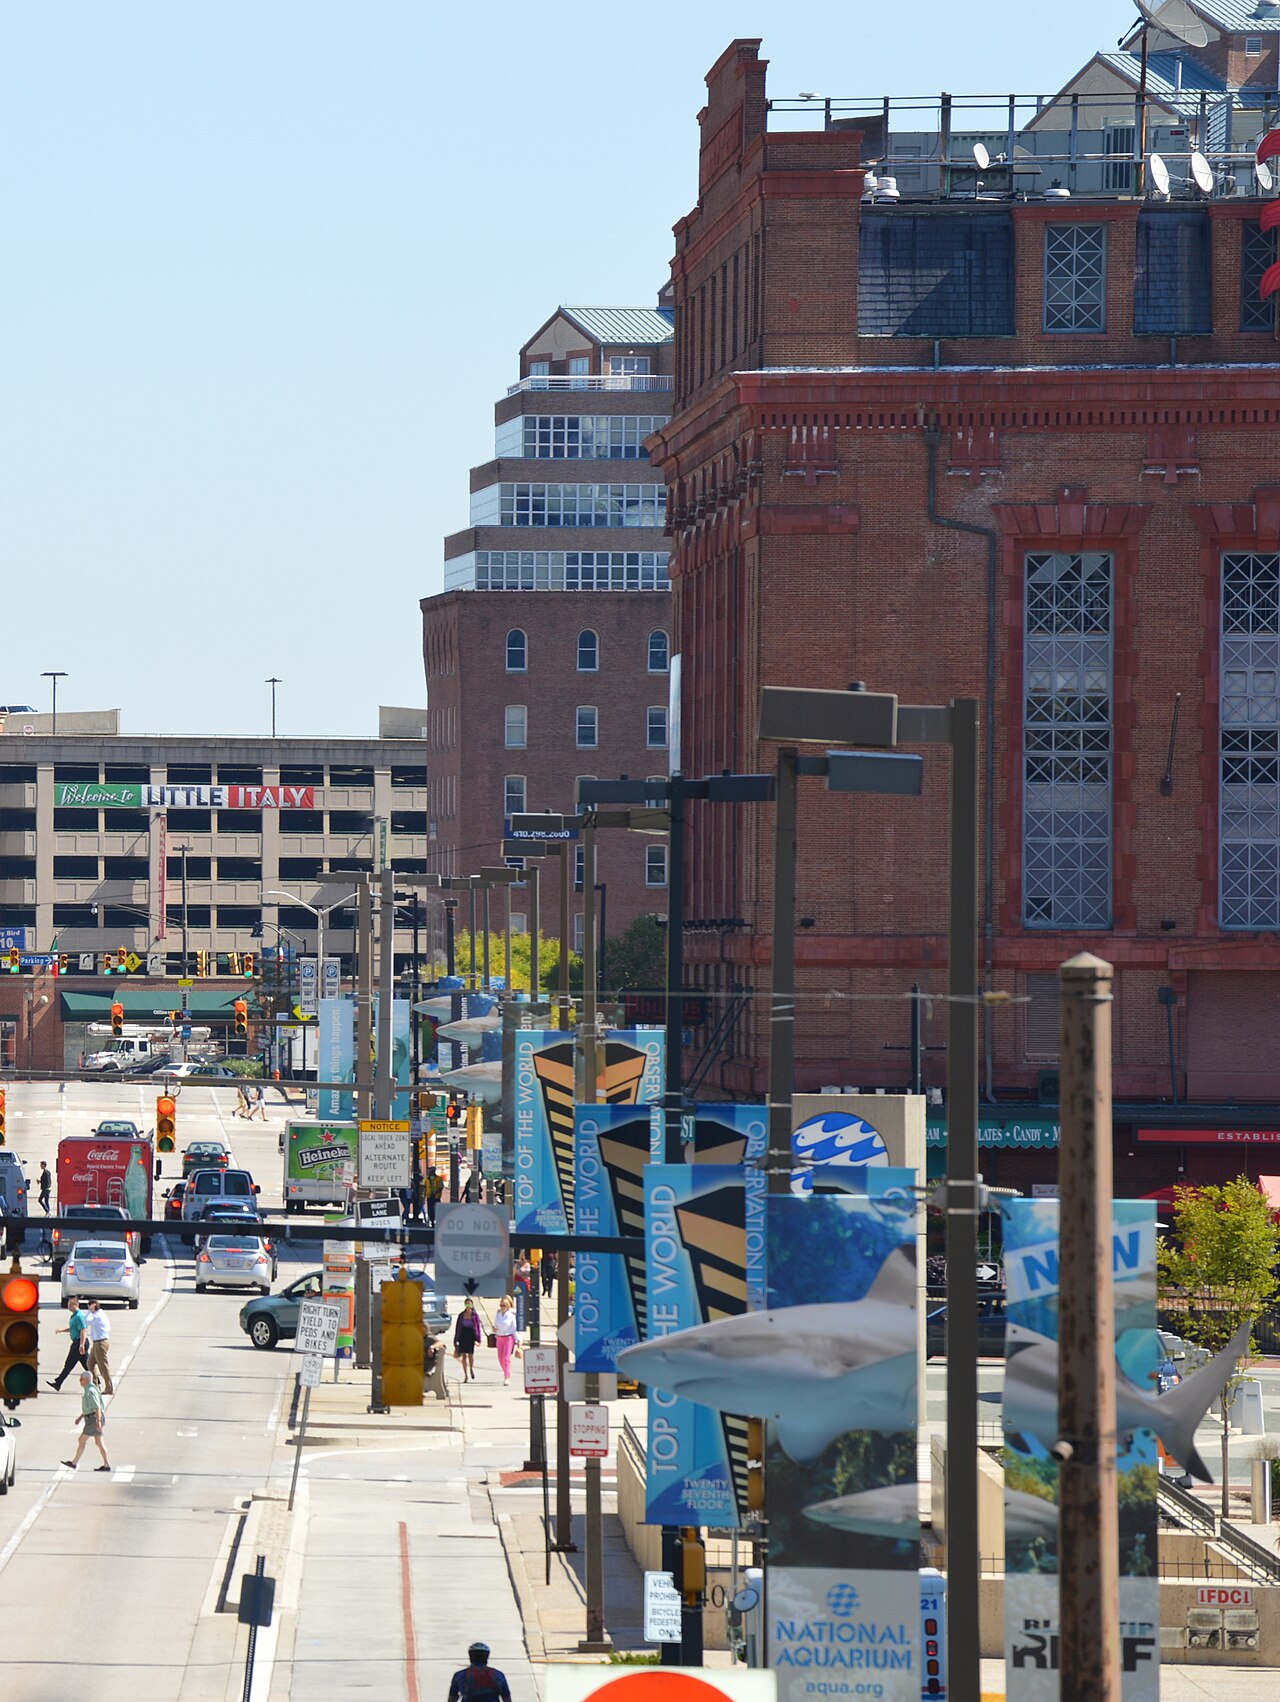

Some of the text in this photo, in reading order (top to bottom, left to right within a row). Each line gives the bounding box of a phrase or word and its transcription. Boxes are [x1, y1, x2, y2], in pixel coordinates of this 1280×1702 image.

[60, 783, 307, 808] Welcome to LITTLE ITALY
[20, 957, 43, 965] Parking
[518, 1042, 534, 1105] WORLD
[328, 1076, 342, 1115] Amazg
[518, 1110, 533, 1140] THE
[681, 1115, 695, 1138] ST
[362, 1134, 408, 1142] LOCAL TRUCK ZONE
[375, 1142, 396, 1150] AHEAD
[518, 1146, 533, 1169] OF
[373, 1162, 397, 1170] ROUTE
[368, 1175, 383, 1183] KEEP
[518, 1175, 533, 1208] TOP
[447, 1219, 499, 1231] DO NOT
[579, 1119, 600, 1335] WORLD HE OF TOP
[452, 1251, 491, 1263] ENTER
[650, 1185, 679, 1341] WORLD HE
[303, 1304, 339, 1318] RIGHT TURN
[302, 1315, 337, 1330] YIELD TO
[301, 1326, 335, 1340] PEDS AND
[305, 1339, 328, 1351] BIKES
[536, 1353, 545, 1361] NO
[526, 1365, 555, 1374] STOPPING
[585, 1410, 595, 1420] NO
[573, 1424, 606, 1434] STOPPING
[652, 1416, 679, 1475] TOP
[684, 1478, 729, 1489] TWENTY
[682, 1489, 730, 1499] SEVENTH
[687, 1500, 724, 1510] FLOOR
[920, 1599, 938, 1611] 21
[658, 1629, 681, 1637] ONLY
[776, 1619, 912, 1645] NATIONAL
[775, 1647, 912, 1670] AQUARIUM
[805, 1681, 884, 1698] aqua.org
